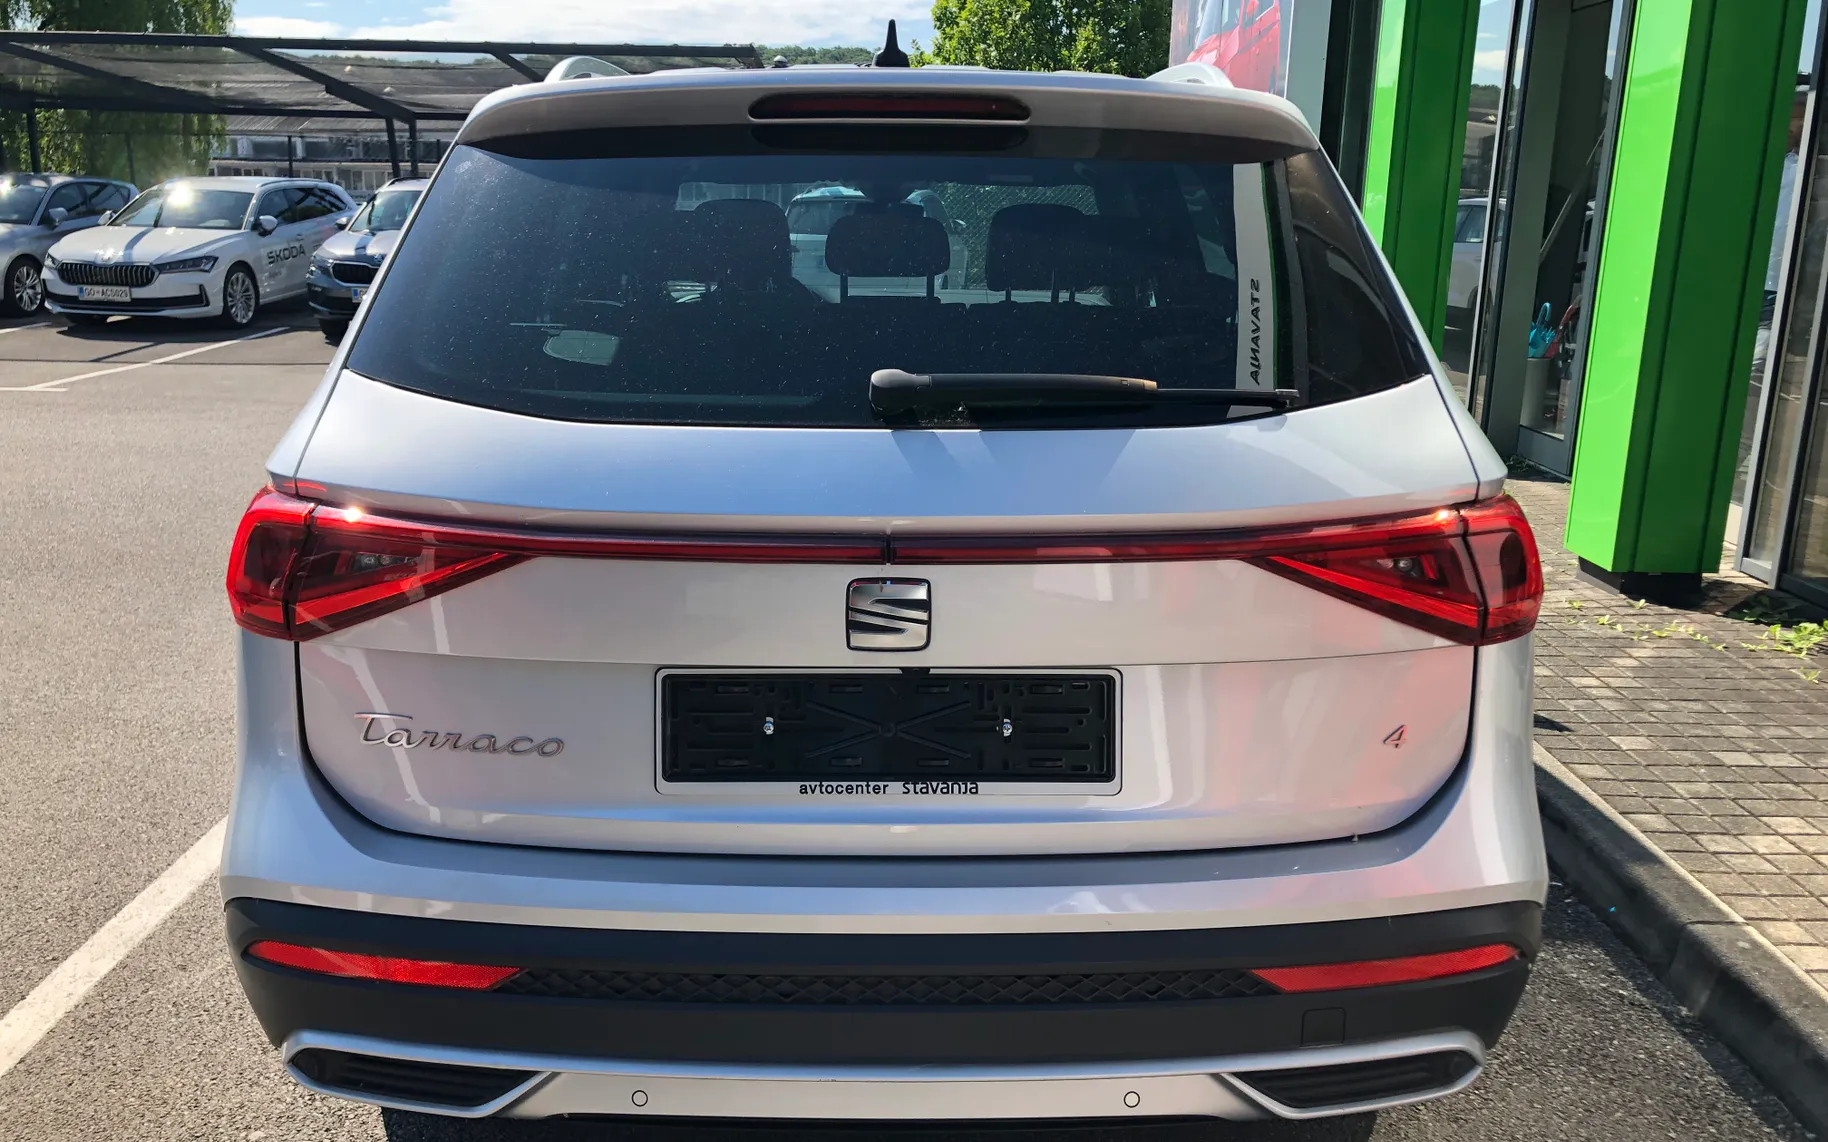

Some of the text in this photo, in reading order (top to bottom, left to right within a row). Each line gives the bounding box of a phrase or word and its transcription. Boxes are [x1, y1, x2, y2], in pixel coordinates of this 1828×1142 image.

[354, 711, 565, 758] Tarraco
[1383, 724, 1408, 749] 4
[799, 781, 979, 795] avtocenter stavanja
